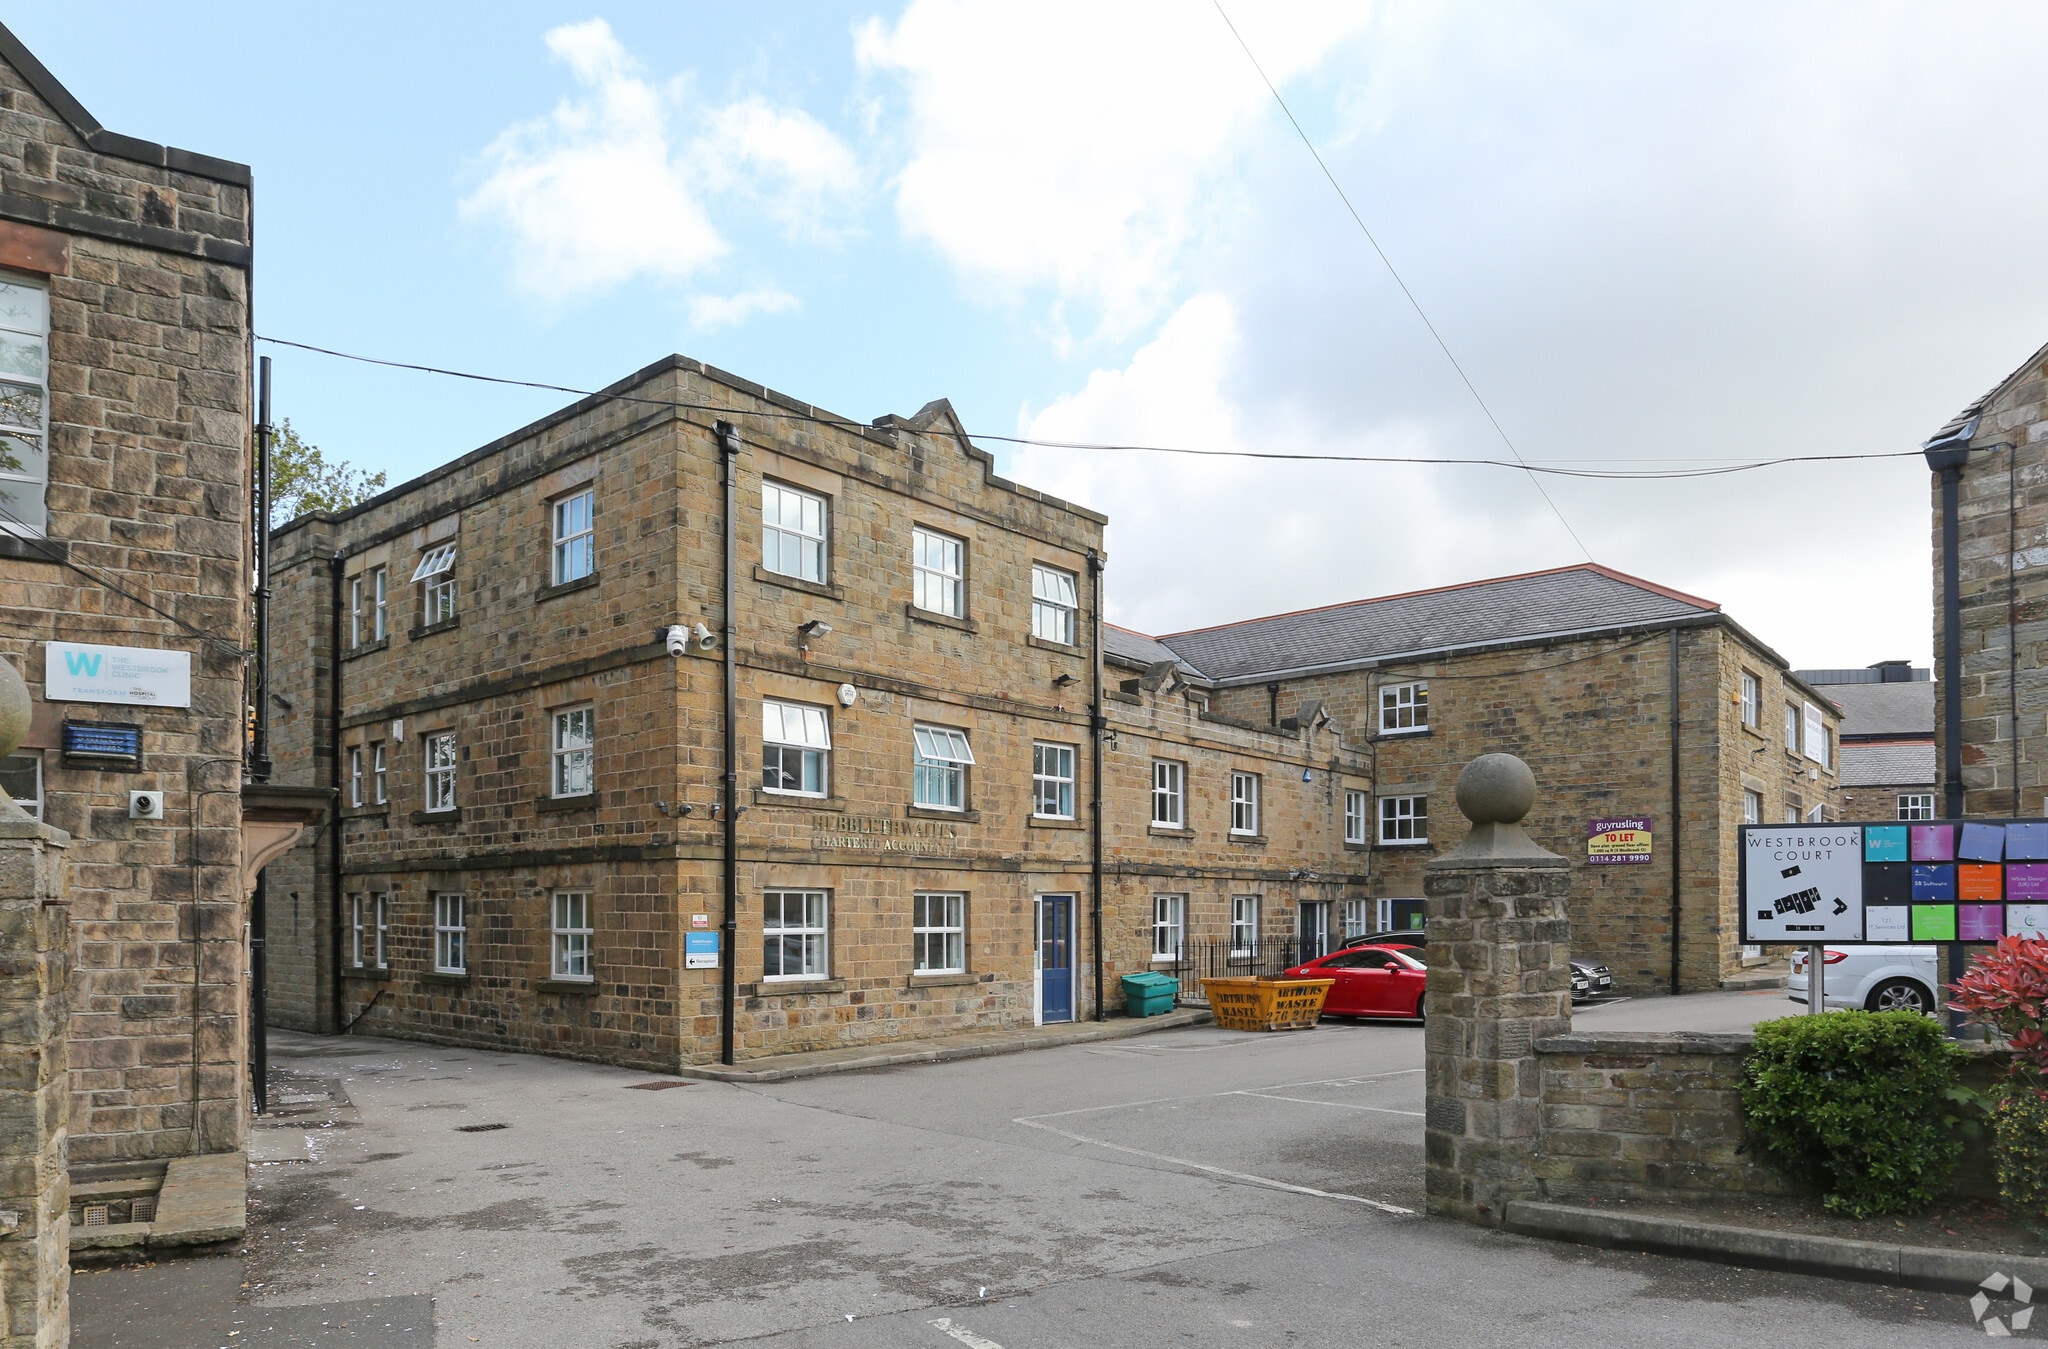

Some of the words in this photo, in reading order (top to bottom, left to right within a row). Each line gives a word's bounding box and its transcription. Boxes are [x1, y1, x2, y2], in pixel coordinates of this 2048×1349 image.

[63, 651, 102, 677] W
[112, 656, 129, 664] THE
[111, 664, 169, 674] WESTBROOK
[111, 671, 141, 679] CLINIC
[72, 687, 127, 696] TRANSFORM
[77, 743, 124, 752] ALARMS
[1596, 820, 1644, 831] guyrusling
[1605, 833, 1617, 842] TO
[1619, 833, 1634, 842] LET
[1748, 836, 1858, 847] WESTBROOK
[813, 835, 881, 849] CHARTERED
[884, 839, 957, 853] ACCOUNTANTS
[1869, 839, 1881, 848] W
[1774, 850, 1832, 860] COURT
[1277, 986, 1322, 998] ARTHURS
[1276, 998, 1318, 1009] WASTE
[1221, 1007, 1257, 1018] WASTE
[1267, 1010, 1288, 1023] 276
[1217, 1015, 1235, 1029] 276
